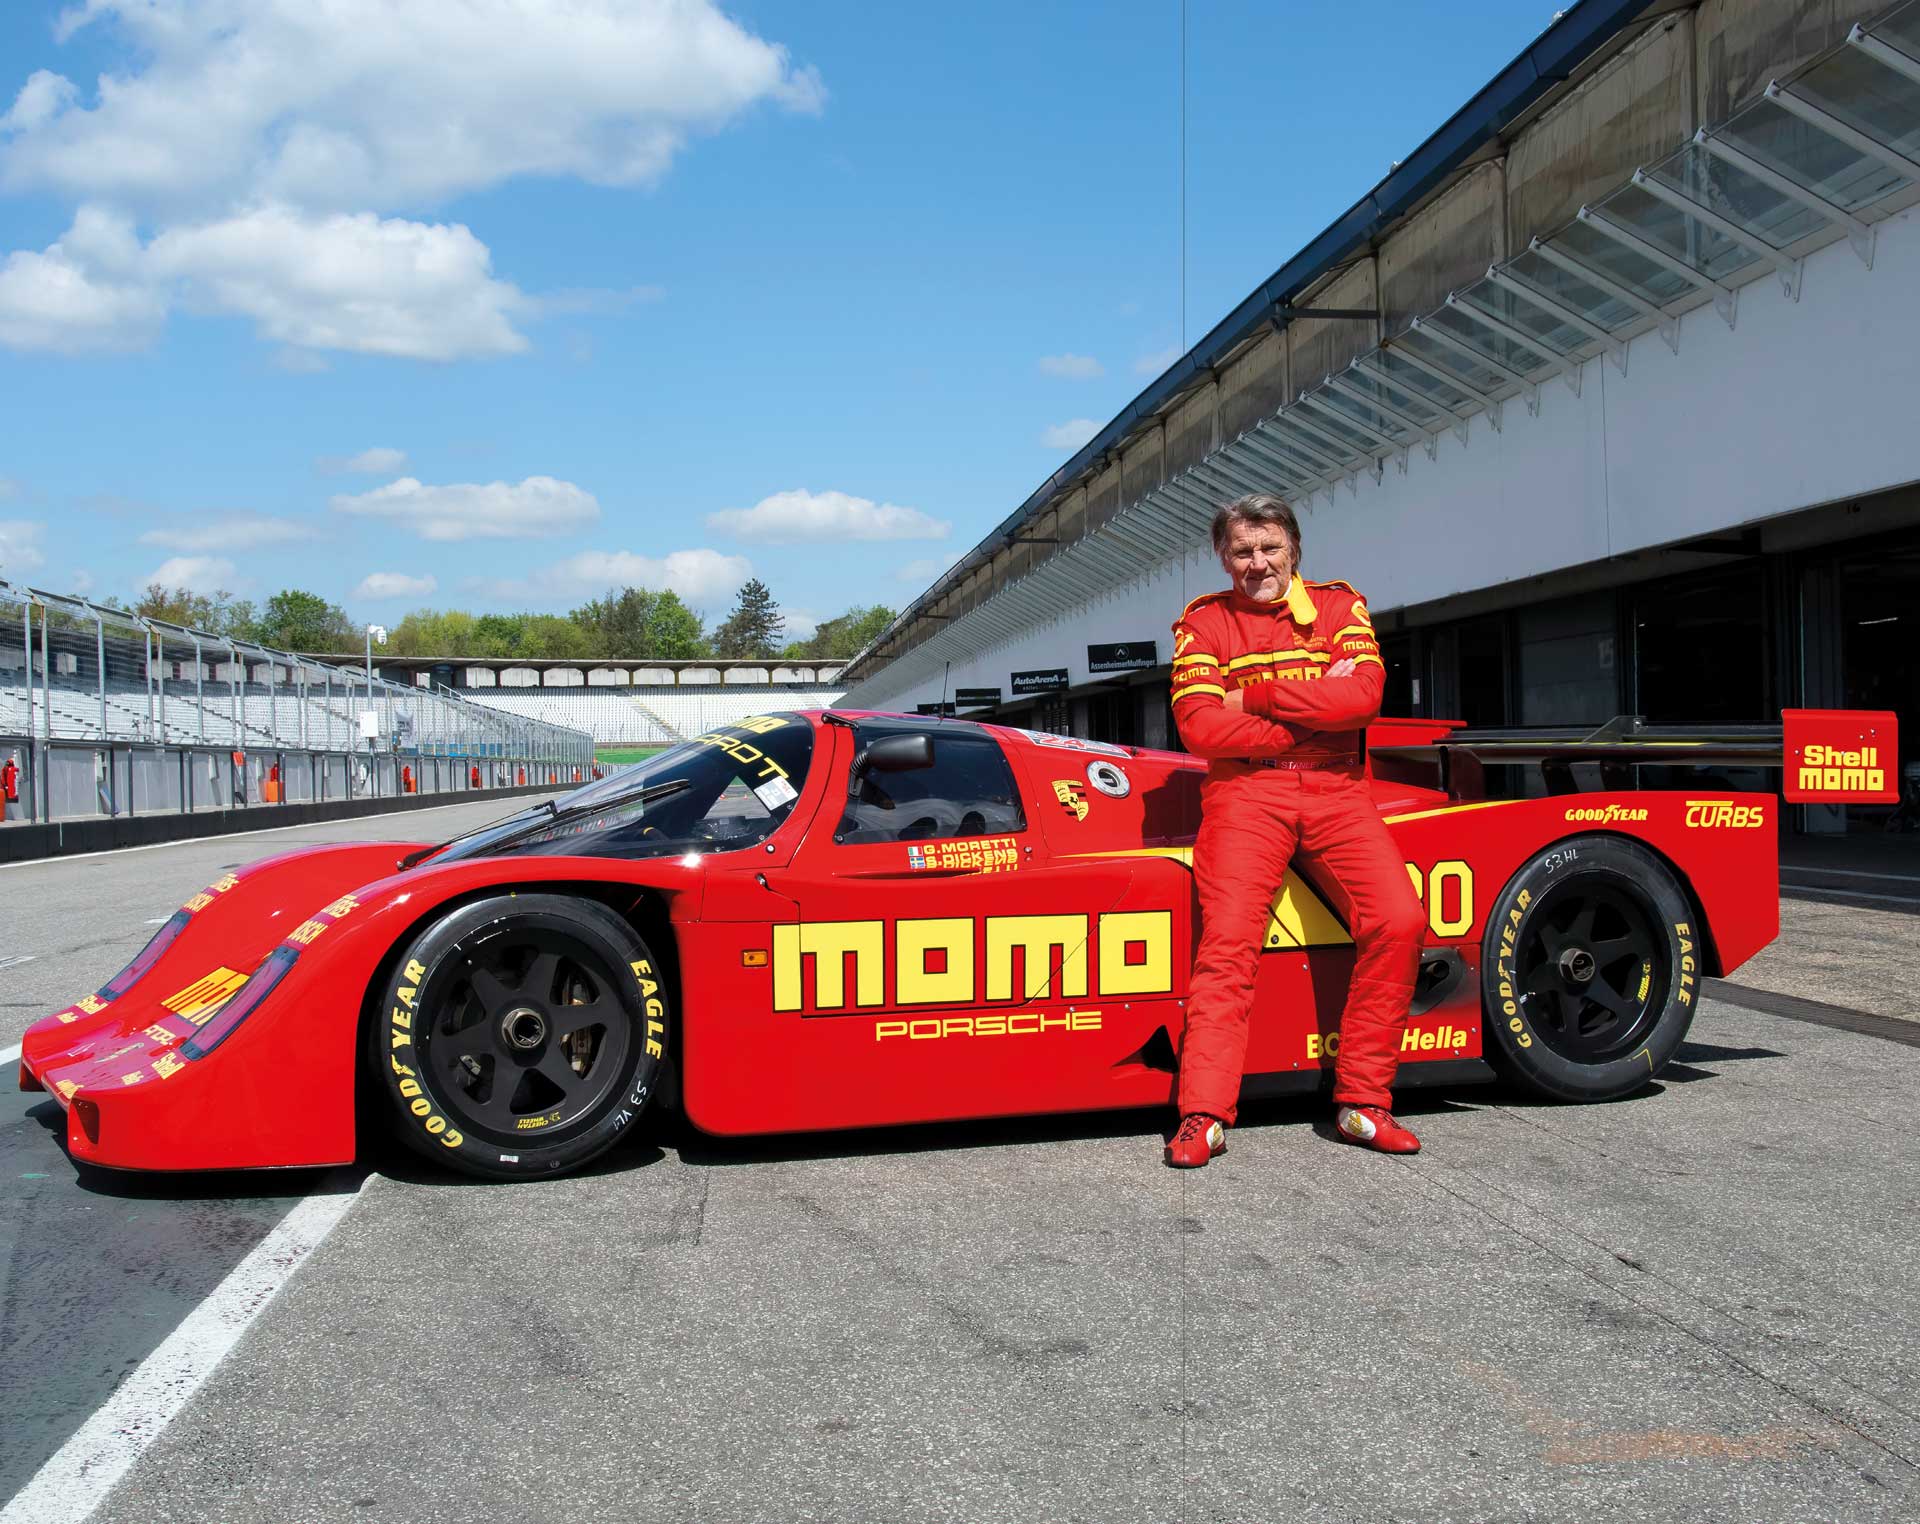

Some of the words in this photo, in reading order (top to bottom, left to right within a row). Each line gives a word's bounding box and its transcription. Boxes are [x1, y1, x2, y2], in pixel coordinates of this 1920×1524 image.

[1342, 641, 1377, 652] mom
[1804, 745, 1877, 767] Shell
[1799, 767, 1884, 791] momo
[1565, 804, 1648, 825] GOODYEAR
[1685, 806, 1764, 828] CURBS
[772, 909, 1173, 1013] momo
[1674, 922, 1696, 1007] EAGLE
[630, 959, 664, 1060] EAGLE
[875, 1011, 1102, 1042] PORSCHE
[1400, 1026, 1468, 1052] Hella
[151, 1051, 186, 1081] Shell
